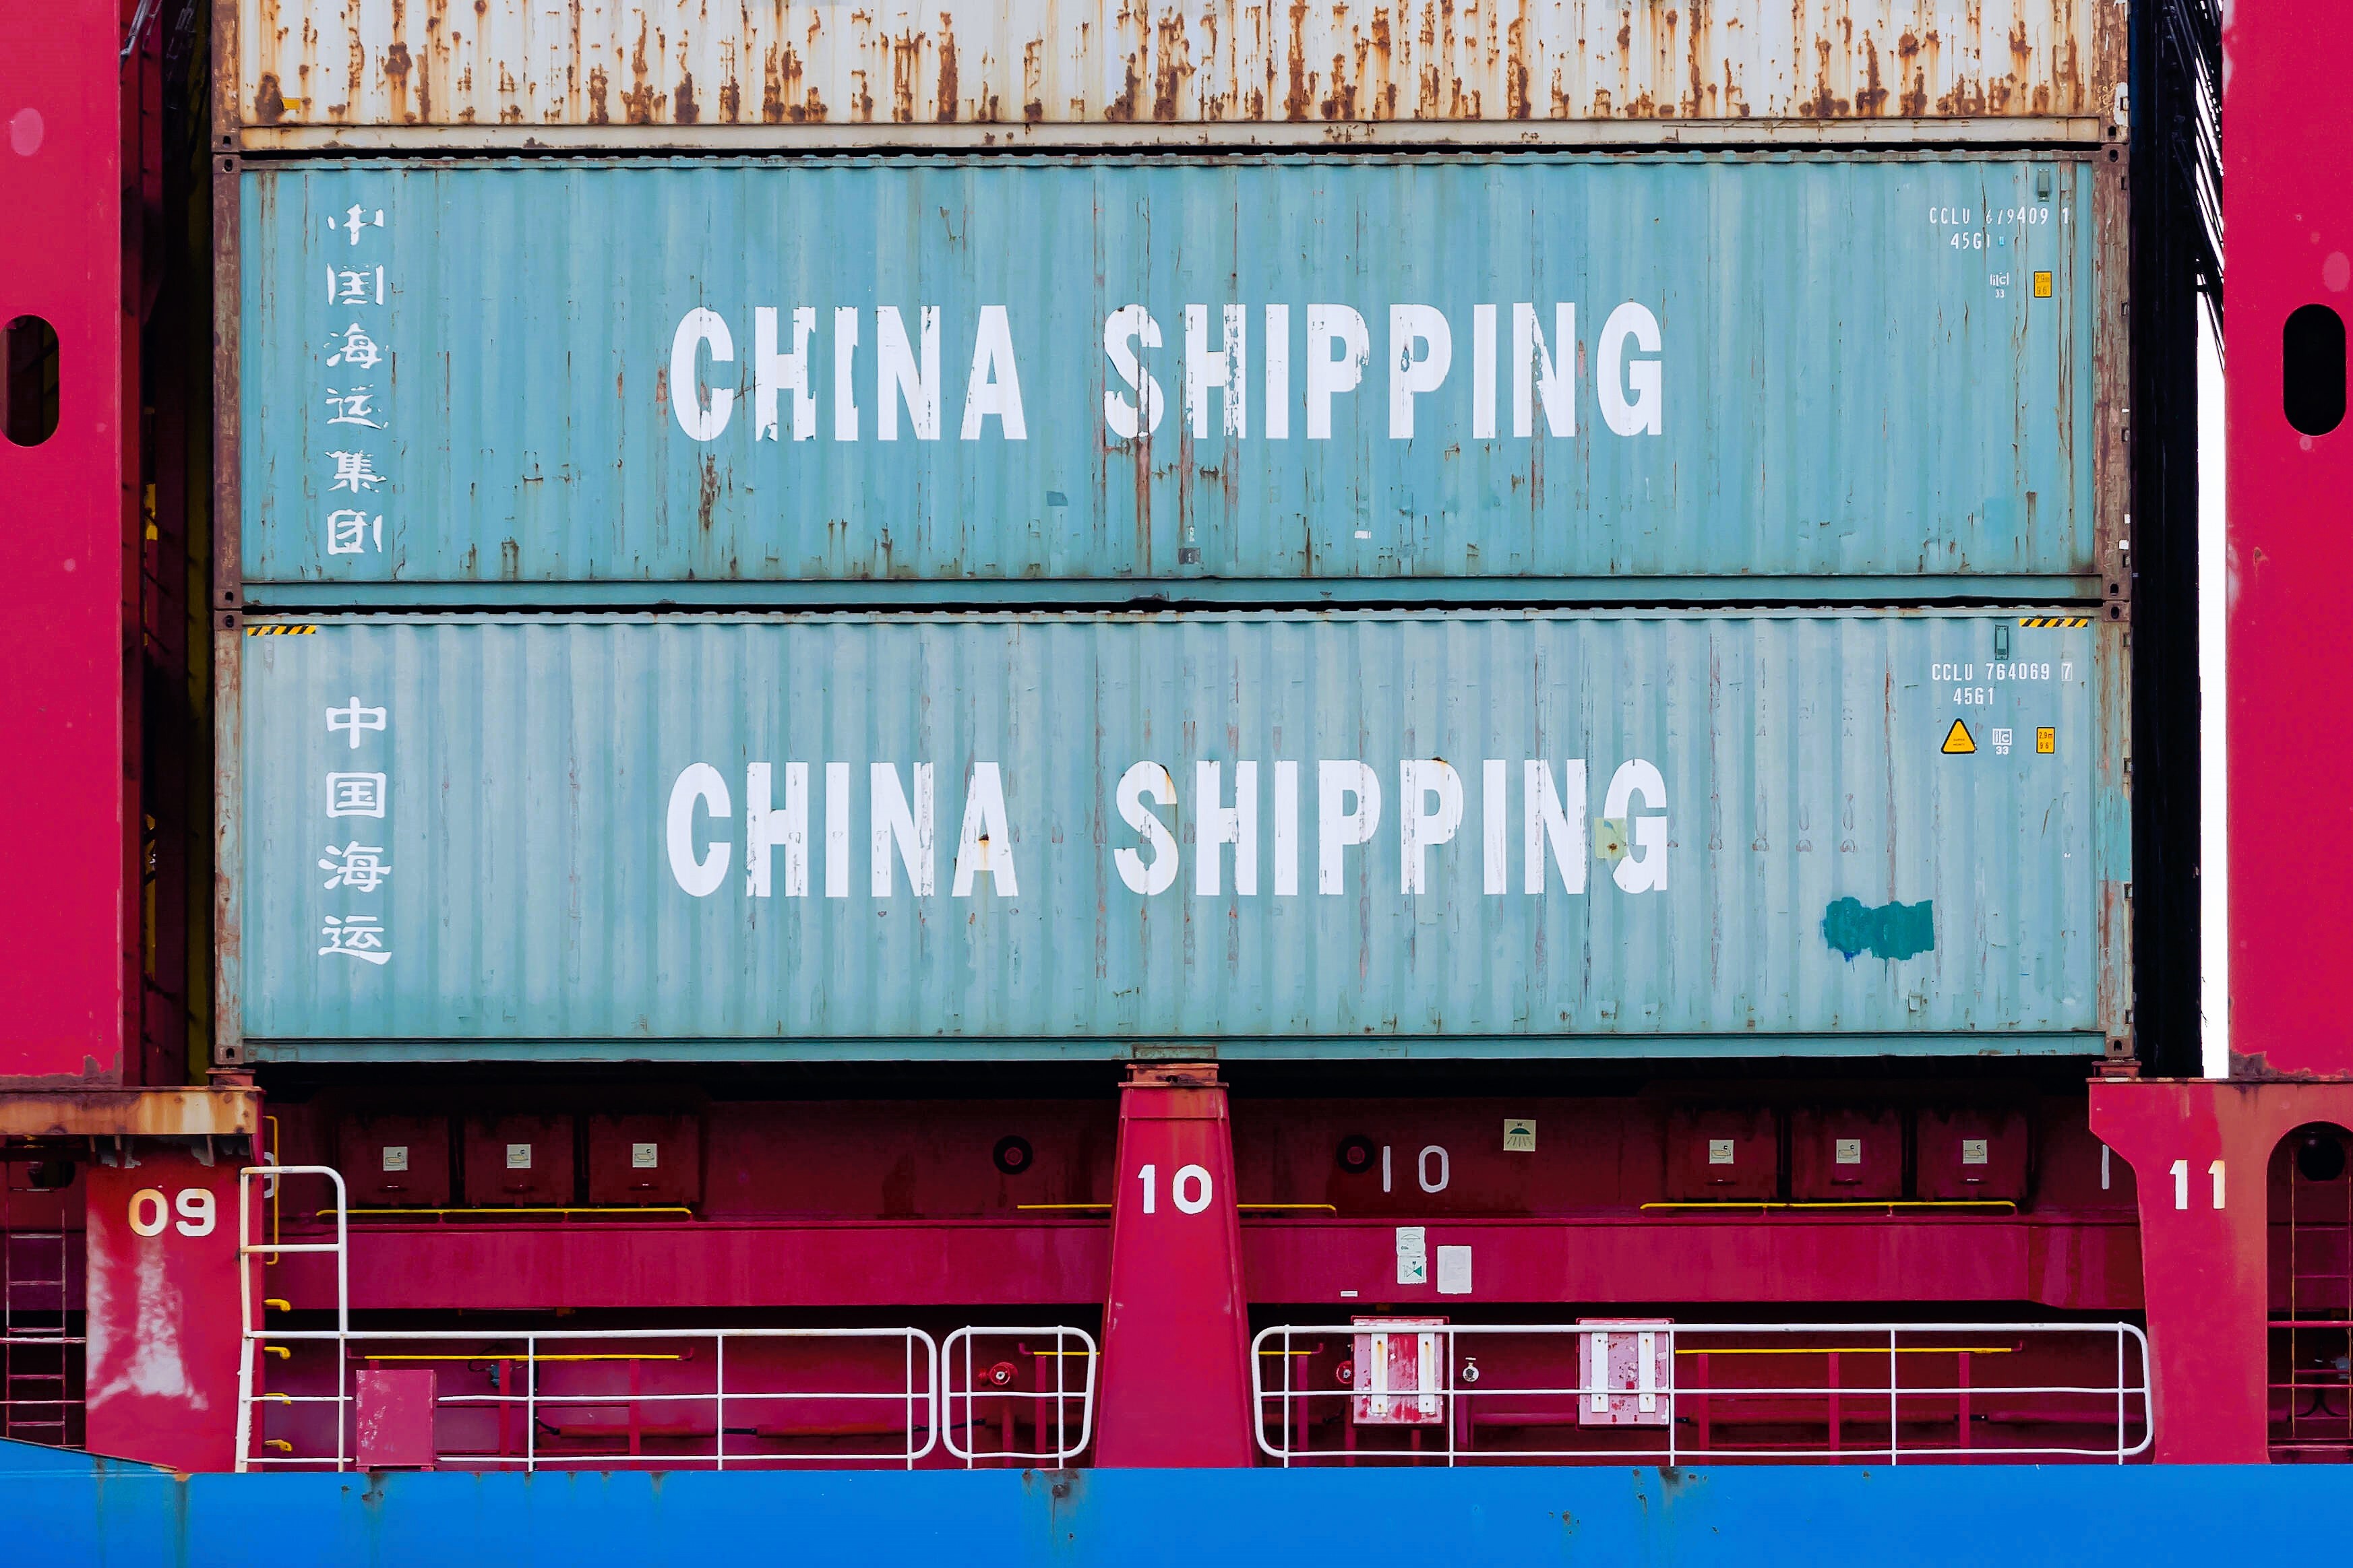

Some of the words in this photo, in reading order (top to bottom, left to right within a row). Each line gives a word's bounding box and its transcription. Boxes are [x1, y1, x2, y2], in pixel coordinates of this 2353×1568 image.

[1930, 207, 1969, 224] CCLU
[2062, 208, 2069, 224] 1
[1951, 232, 1990, 249] 45G1
[1995, 288, 2005, 298] 33
[324, 203, 389, 555] 中国海运集团
[670, 305, 1027, 442] CHINA
[1103, 303, 1661, 439] SHIPPING
[1932, 663, 1974, 681] CCLU
[1986, 662, 2050, 681] 764069
[2062, 663, 2071, 680] 7
[1953, 687, 1994, 705] 45G1
[1996, 746, 2009, 755] 33
[318, 696, 392, 965] 中国海运
[667, 761, 1018, 898] CHINA
[1114, 759, 1668, 896] SHIPPING
[1138, 1164, 1213, 1214] 10
[1382, 1145, 1449, 1193] 10
[2169, 1160, 2226, 1210] 11
[128, 1187, 216, 1237] 09
